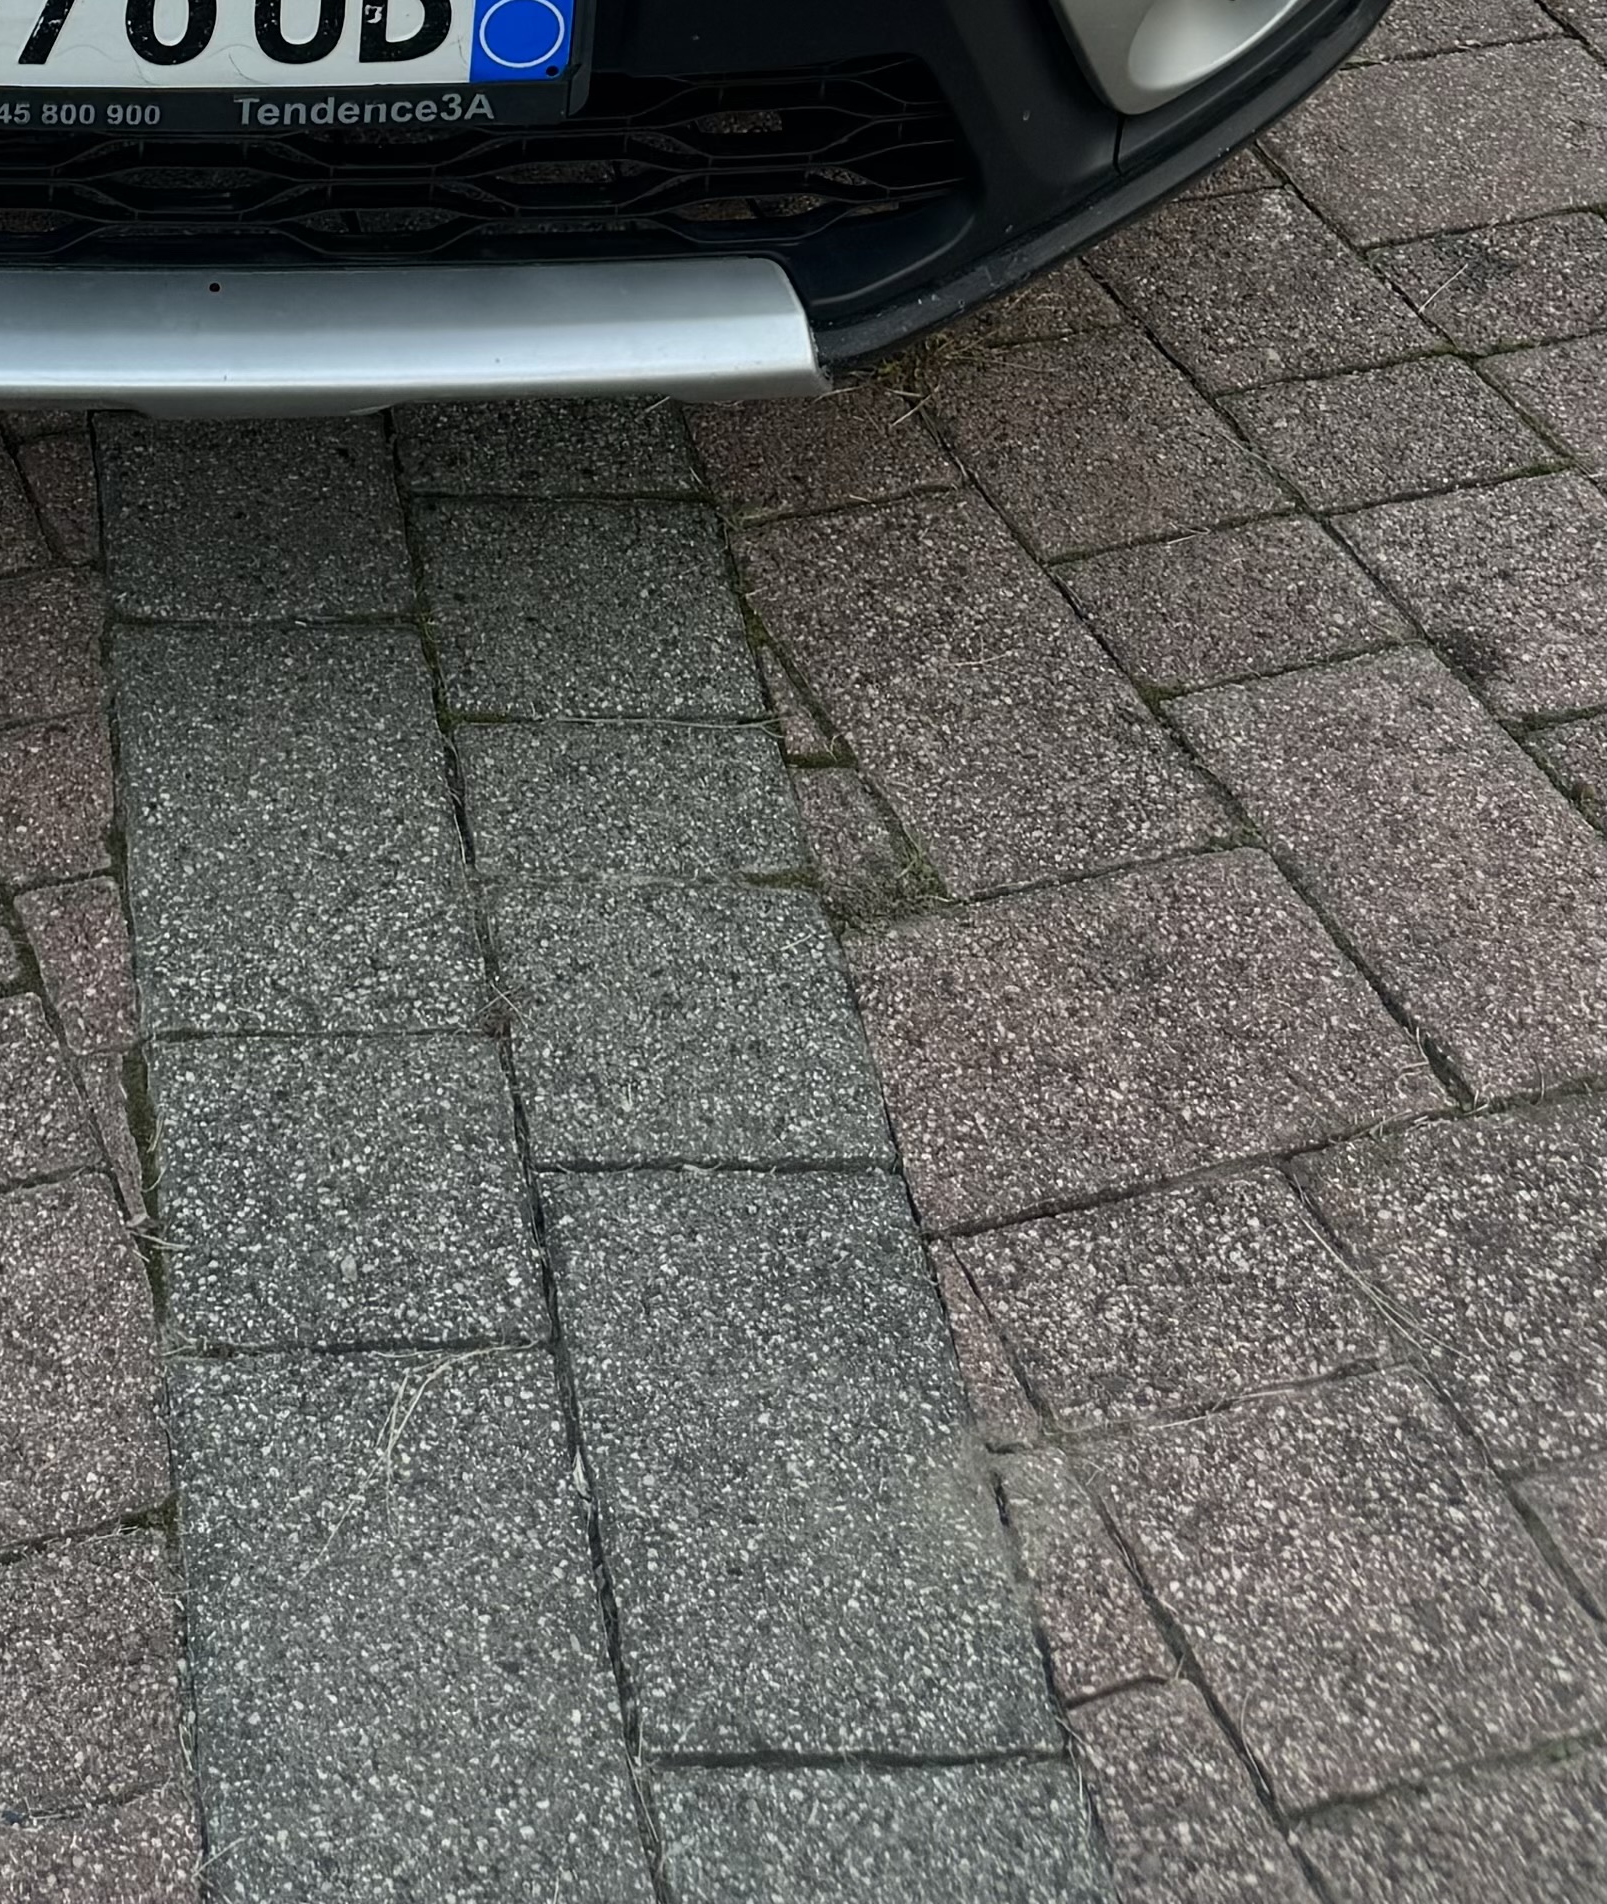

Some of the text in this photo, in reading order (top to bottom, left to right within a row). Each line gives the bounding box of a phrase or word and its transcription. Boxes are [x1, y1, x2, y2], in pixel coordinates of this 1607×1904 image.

[41, 104, 95, 125] 800
[106, 104, 161, 125] 900
[233, 93, 495, 126] Tendence3A
